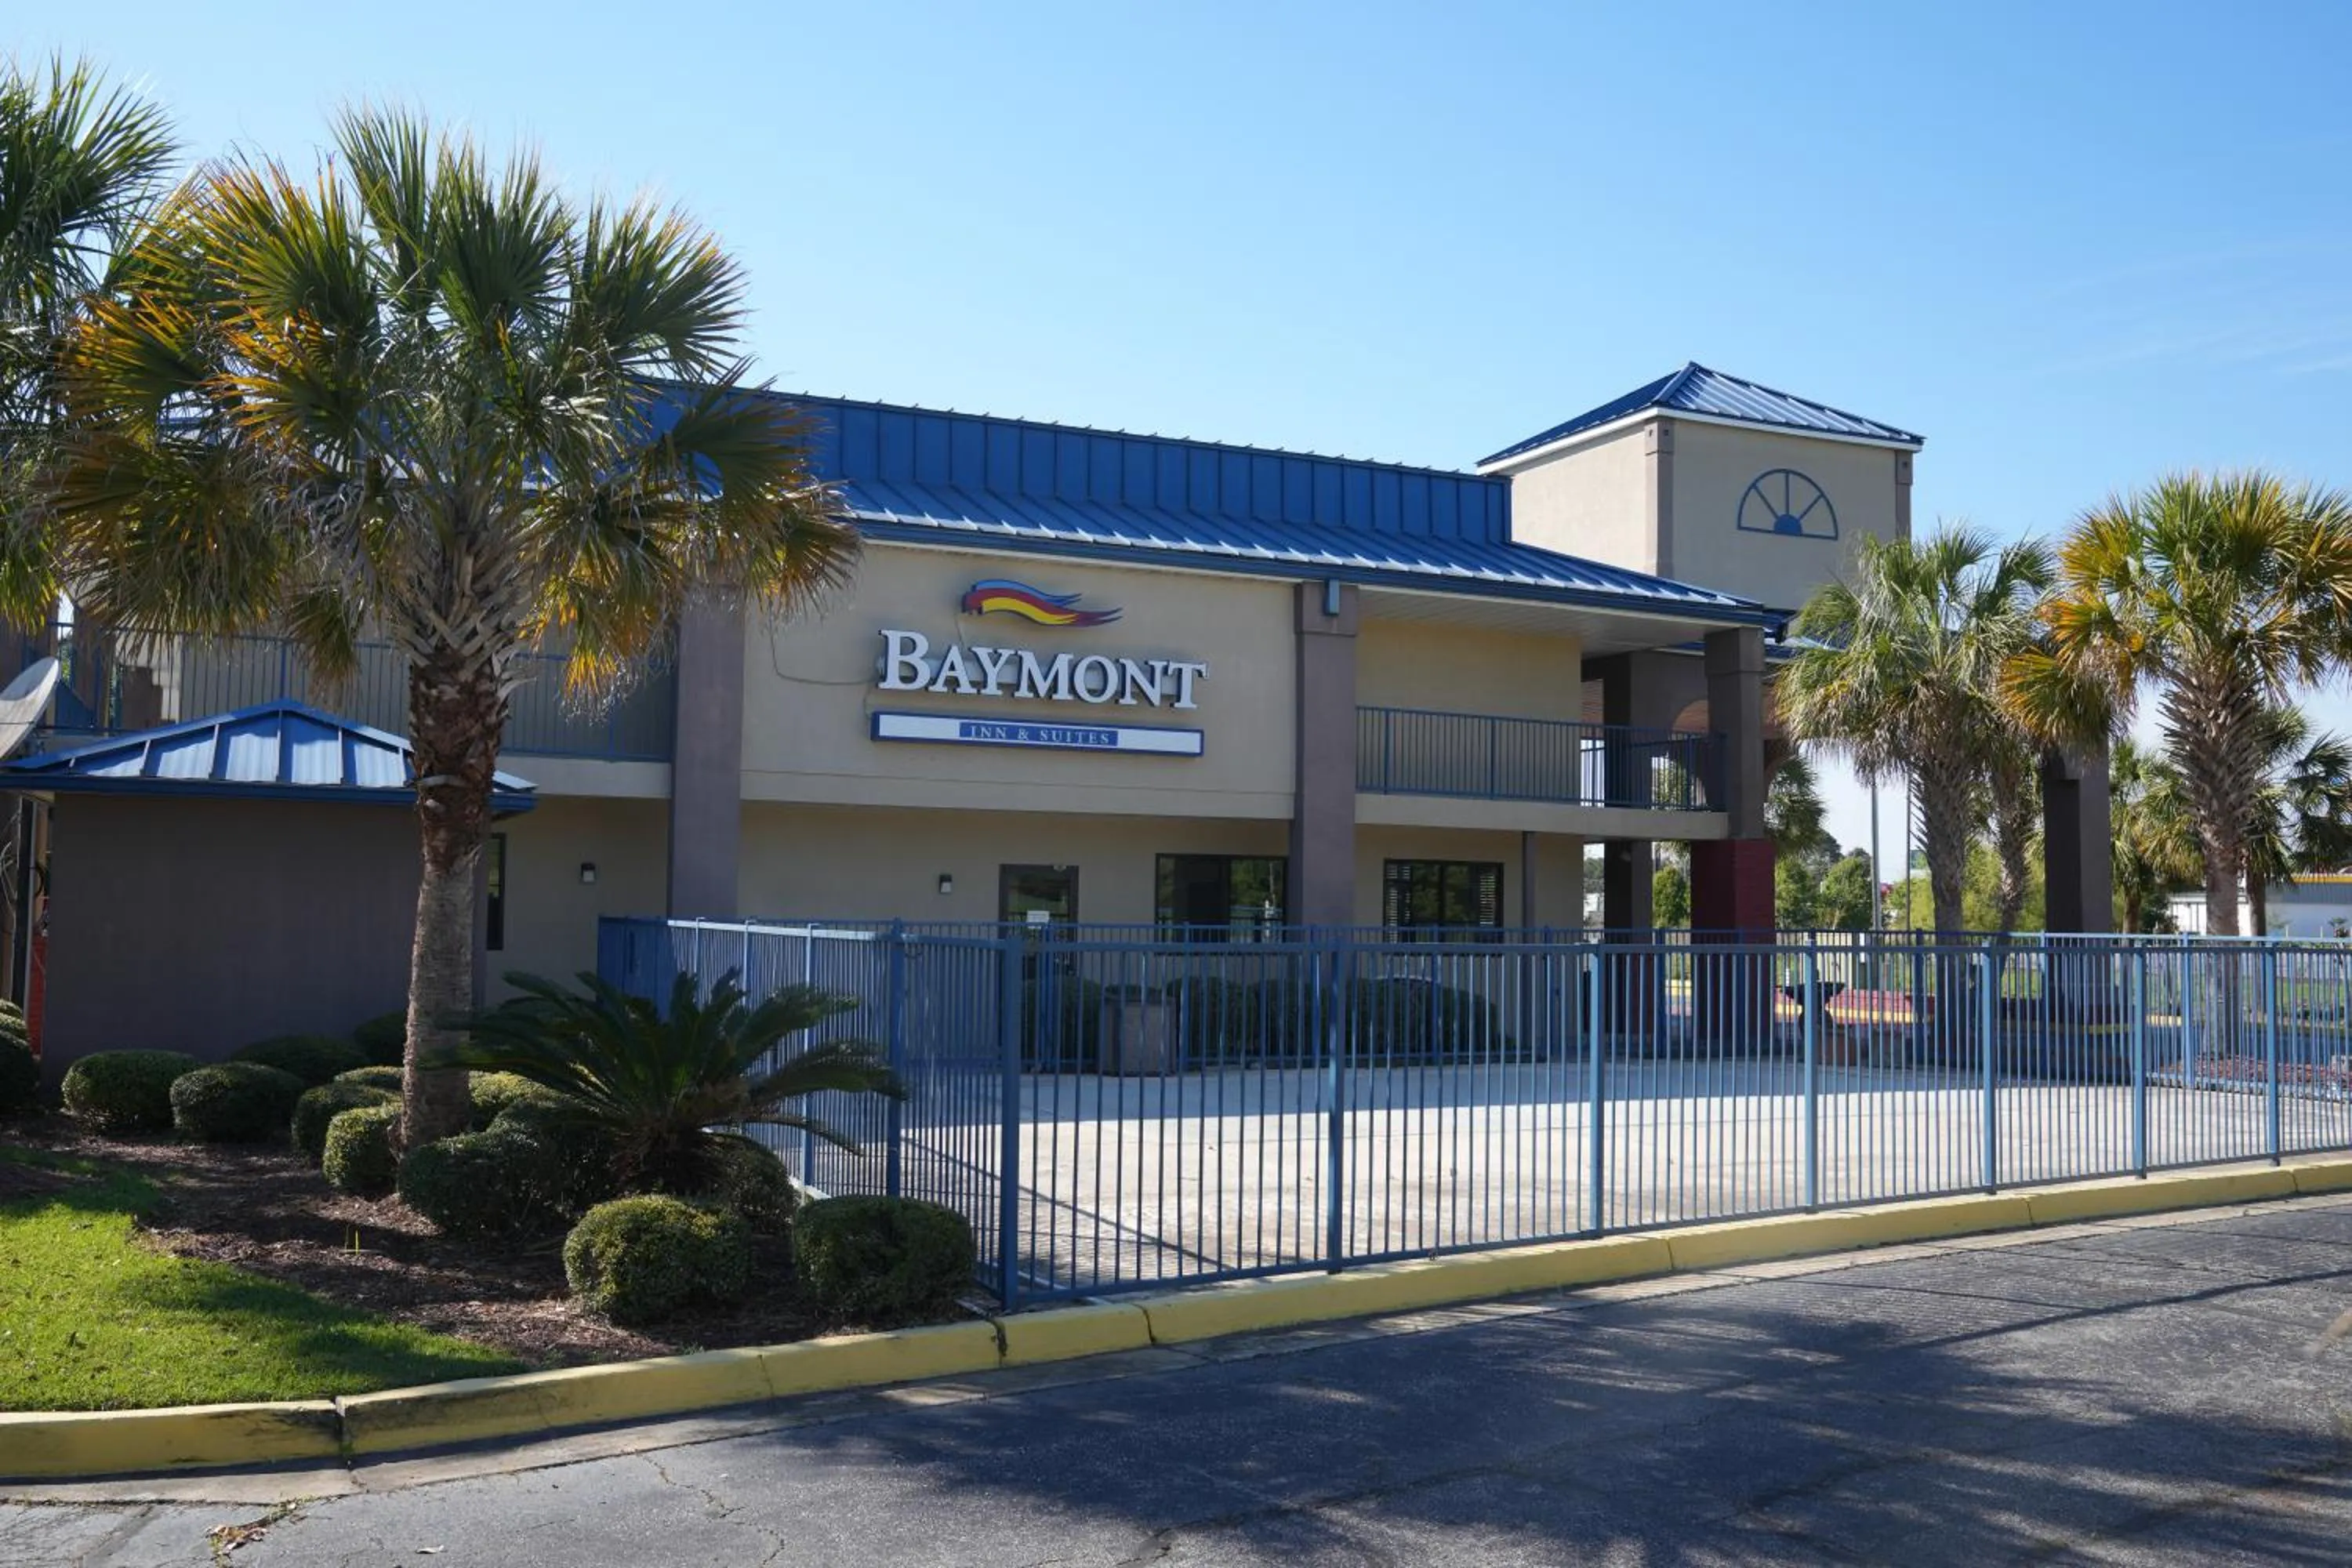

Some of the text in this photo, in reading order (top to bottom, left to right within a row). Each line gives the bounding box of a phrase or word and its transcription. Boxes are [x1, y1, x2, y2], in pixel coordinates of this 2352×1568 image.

[878, 629, 1208, 709] BAYMONT
[970, 725, 1110, 744] INN & SUITES
